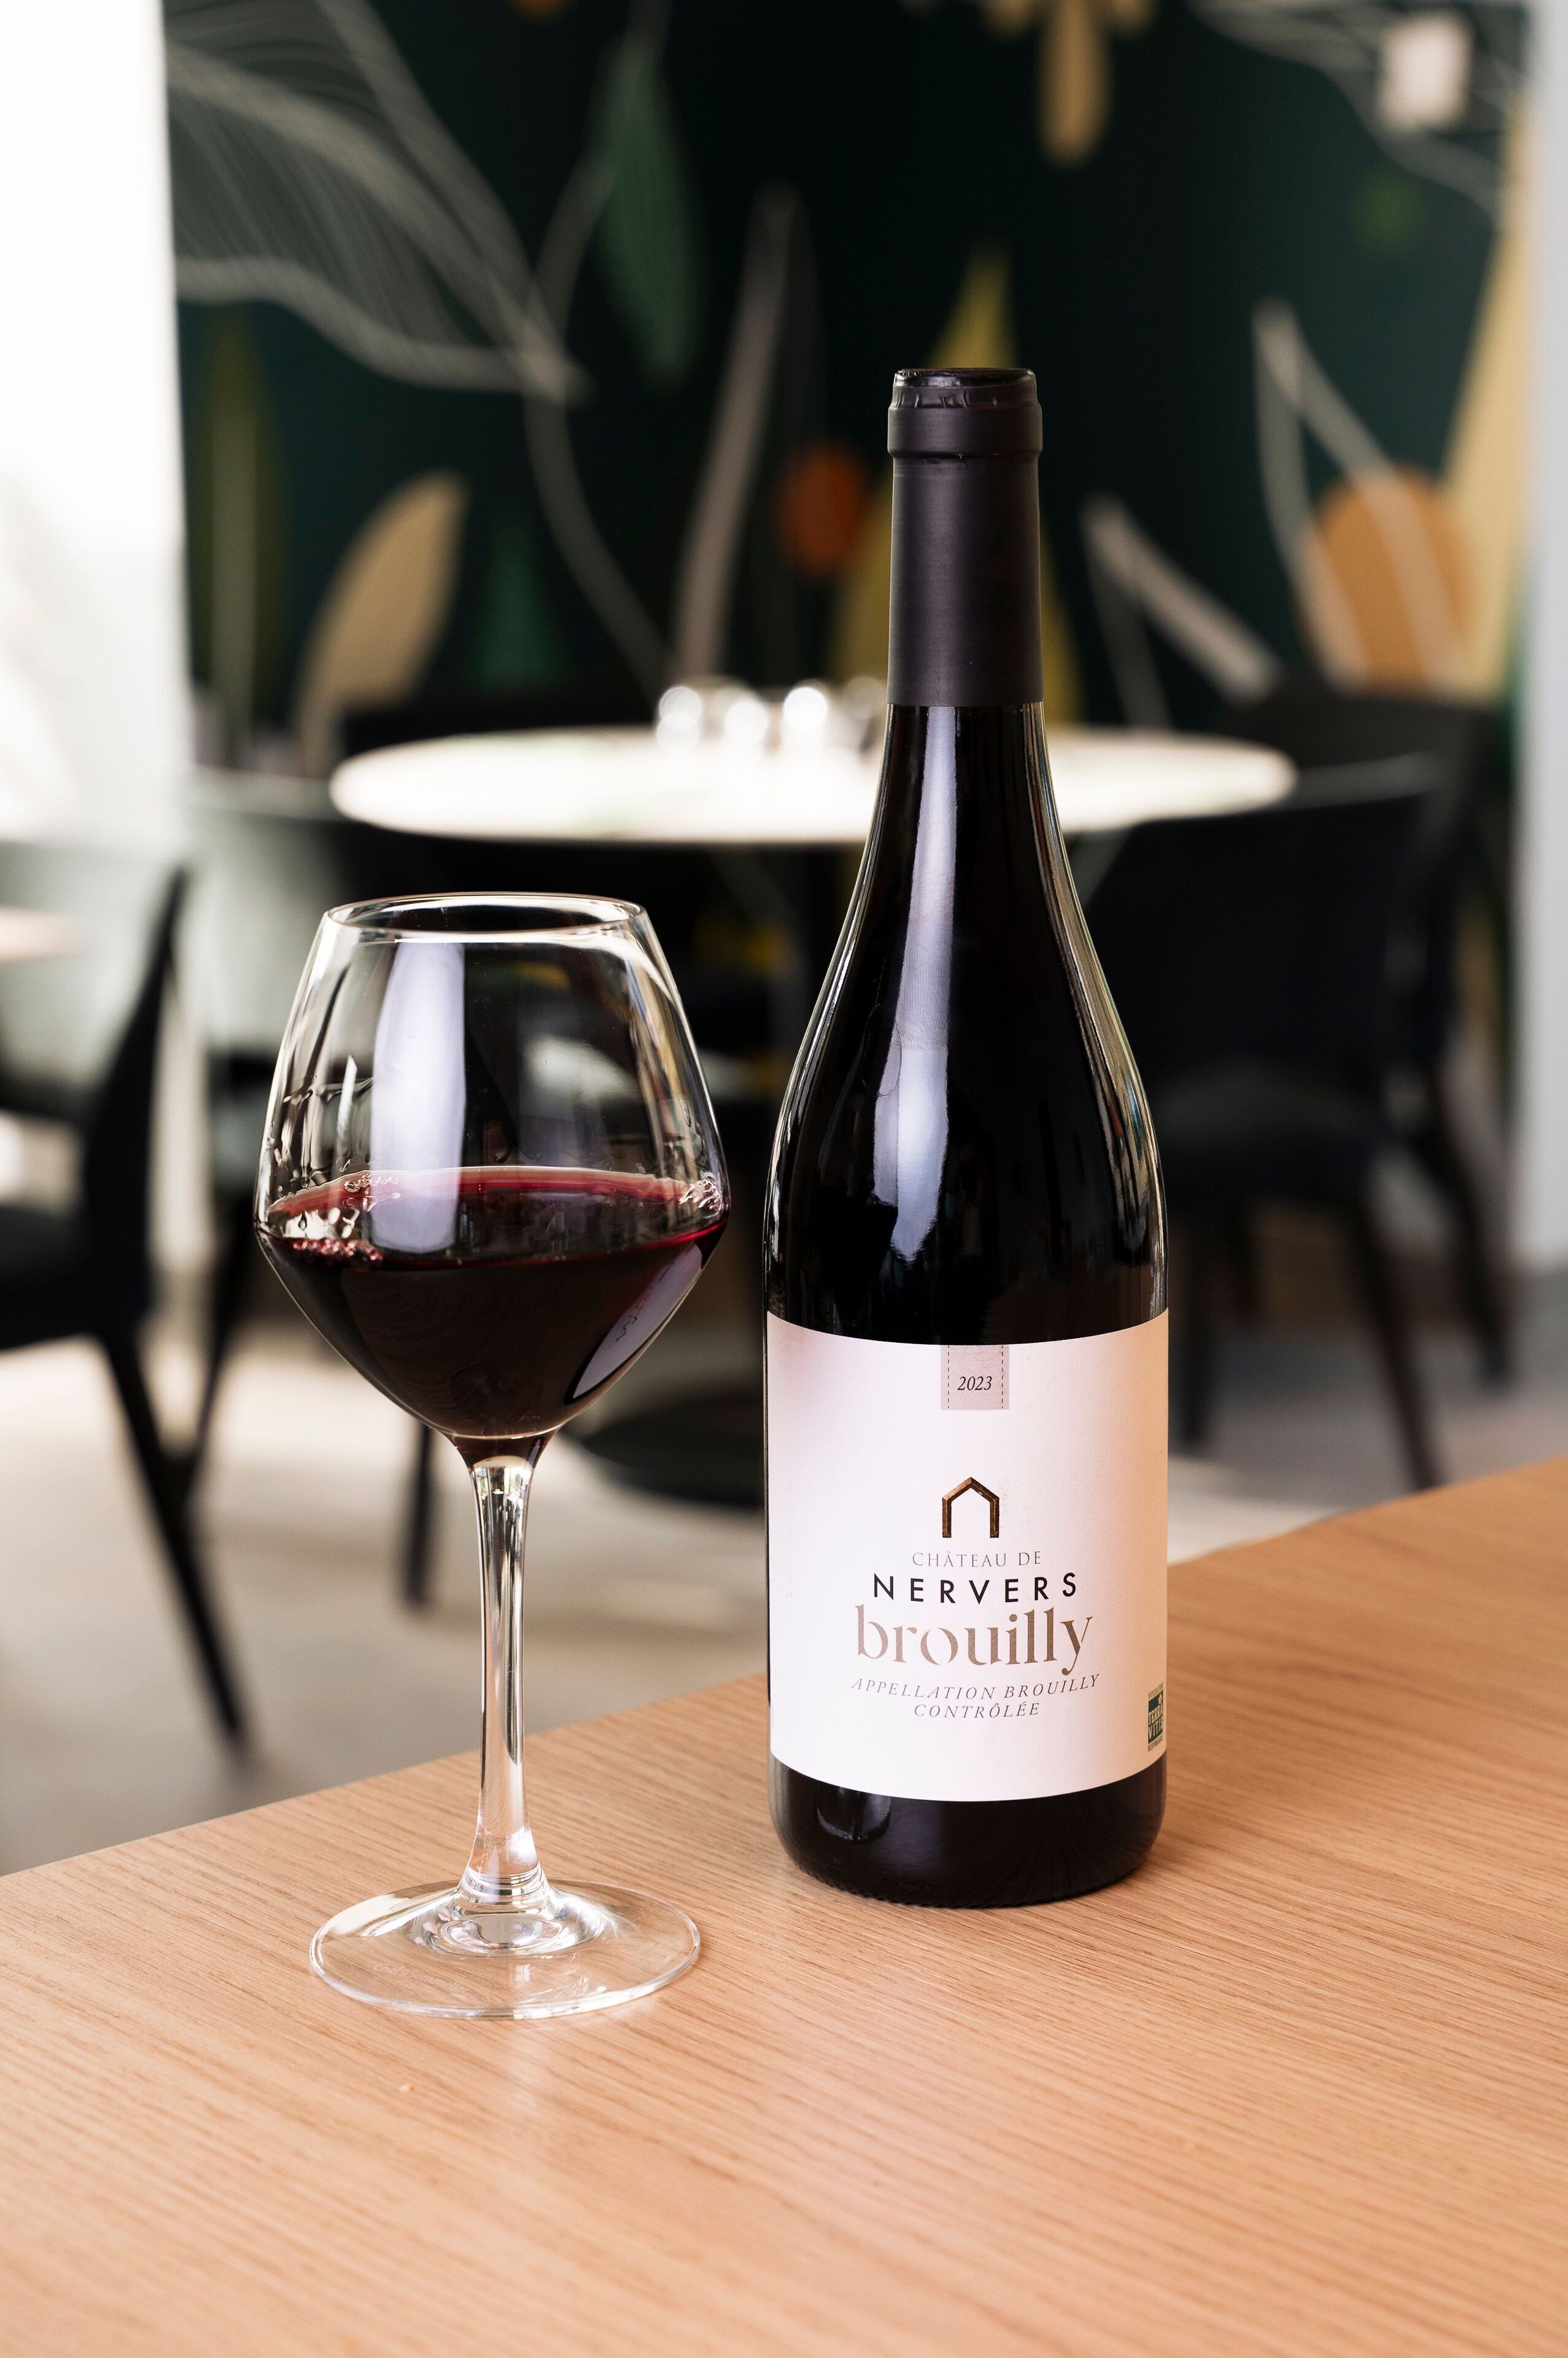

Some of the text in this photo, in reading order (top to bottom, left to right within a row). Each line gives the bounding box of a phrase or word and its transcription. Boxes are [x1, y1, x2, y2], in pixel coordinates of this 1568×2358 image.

[957, 1376, 993, 1391] 2023
[912, 1551, 1041, 1568] CHÂTEAU DE
[874, 1572, 1076, 1605] NERVERS
[855, 1603, 1093, 1676] brouilly
[851, 1673, 1100, 1699] APPELLATION BROUILLY
[914, 1701, 1040, 1719] CONTRÔLÉE
